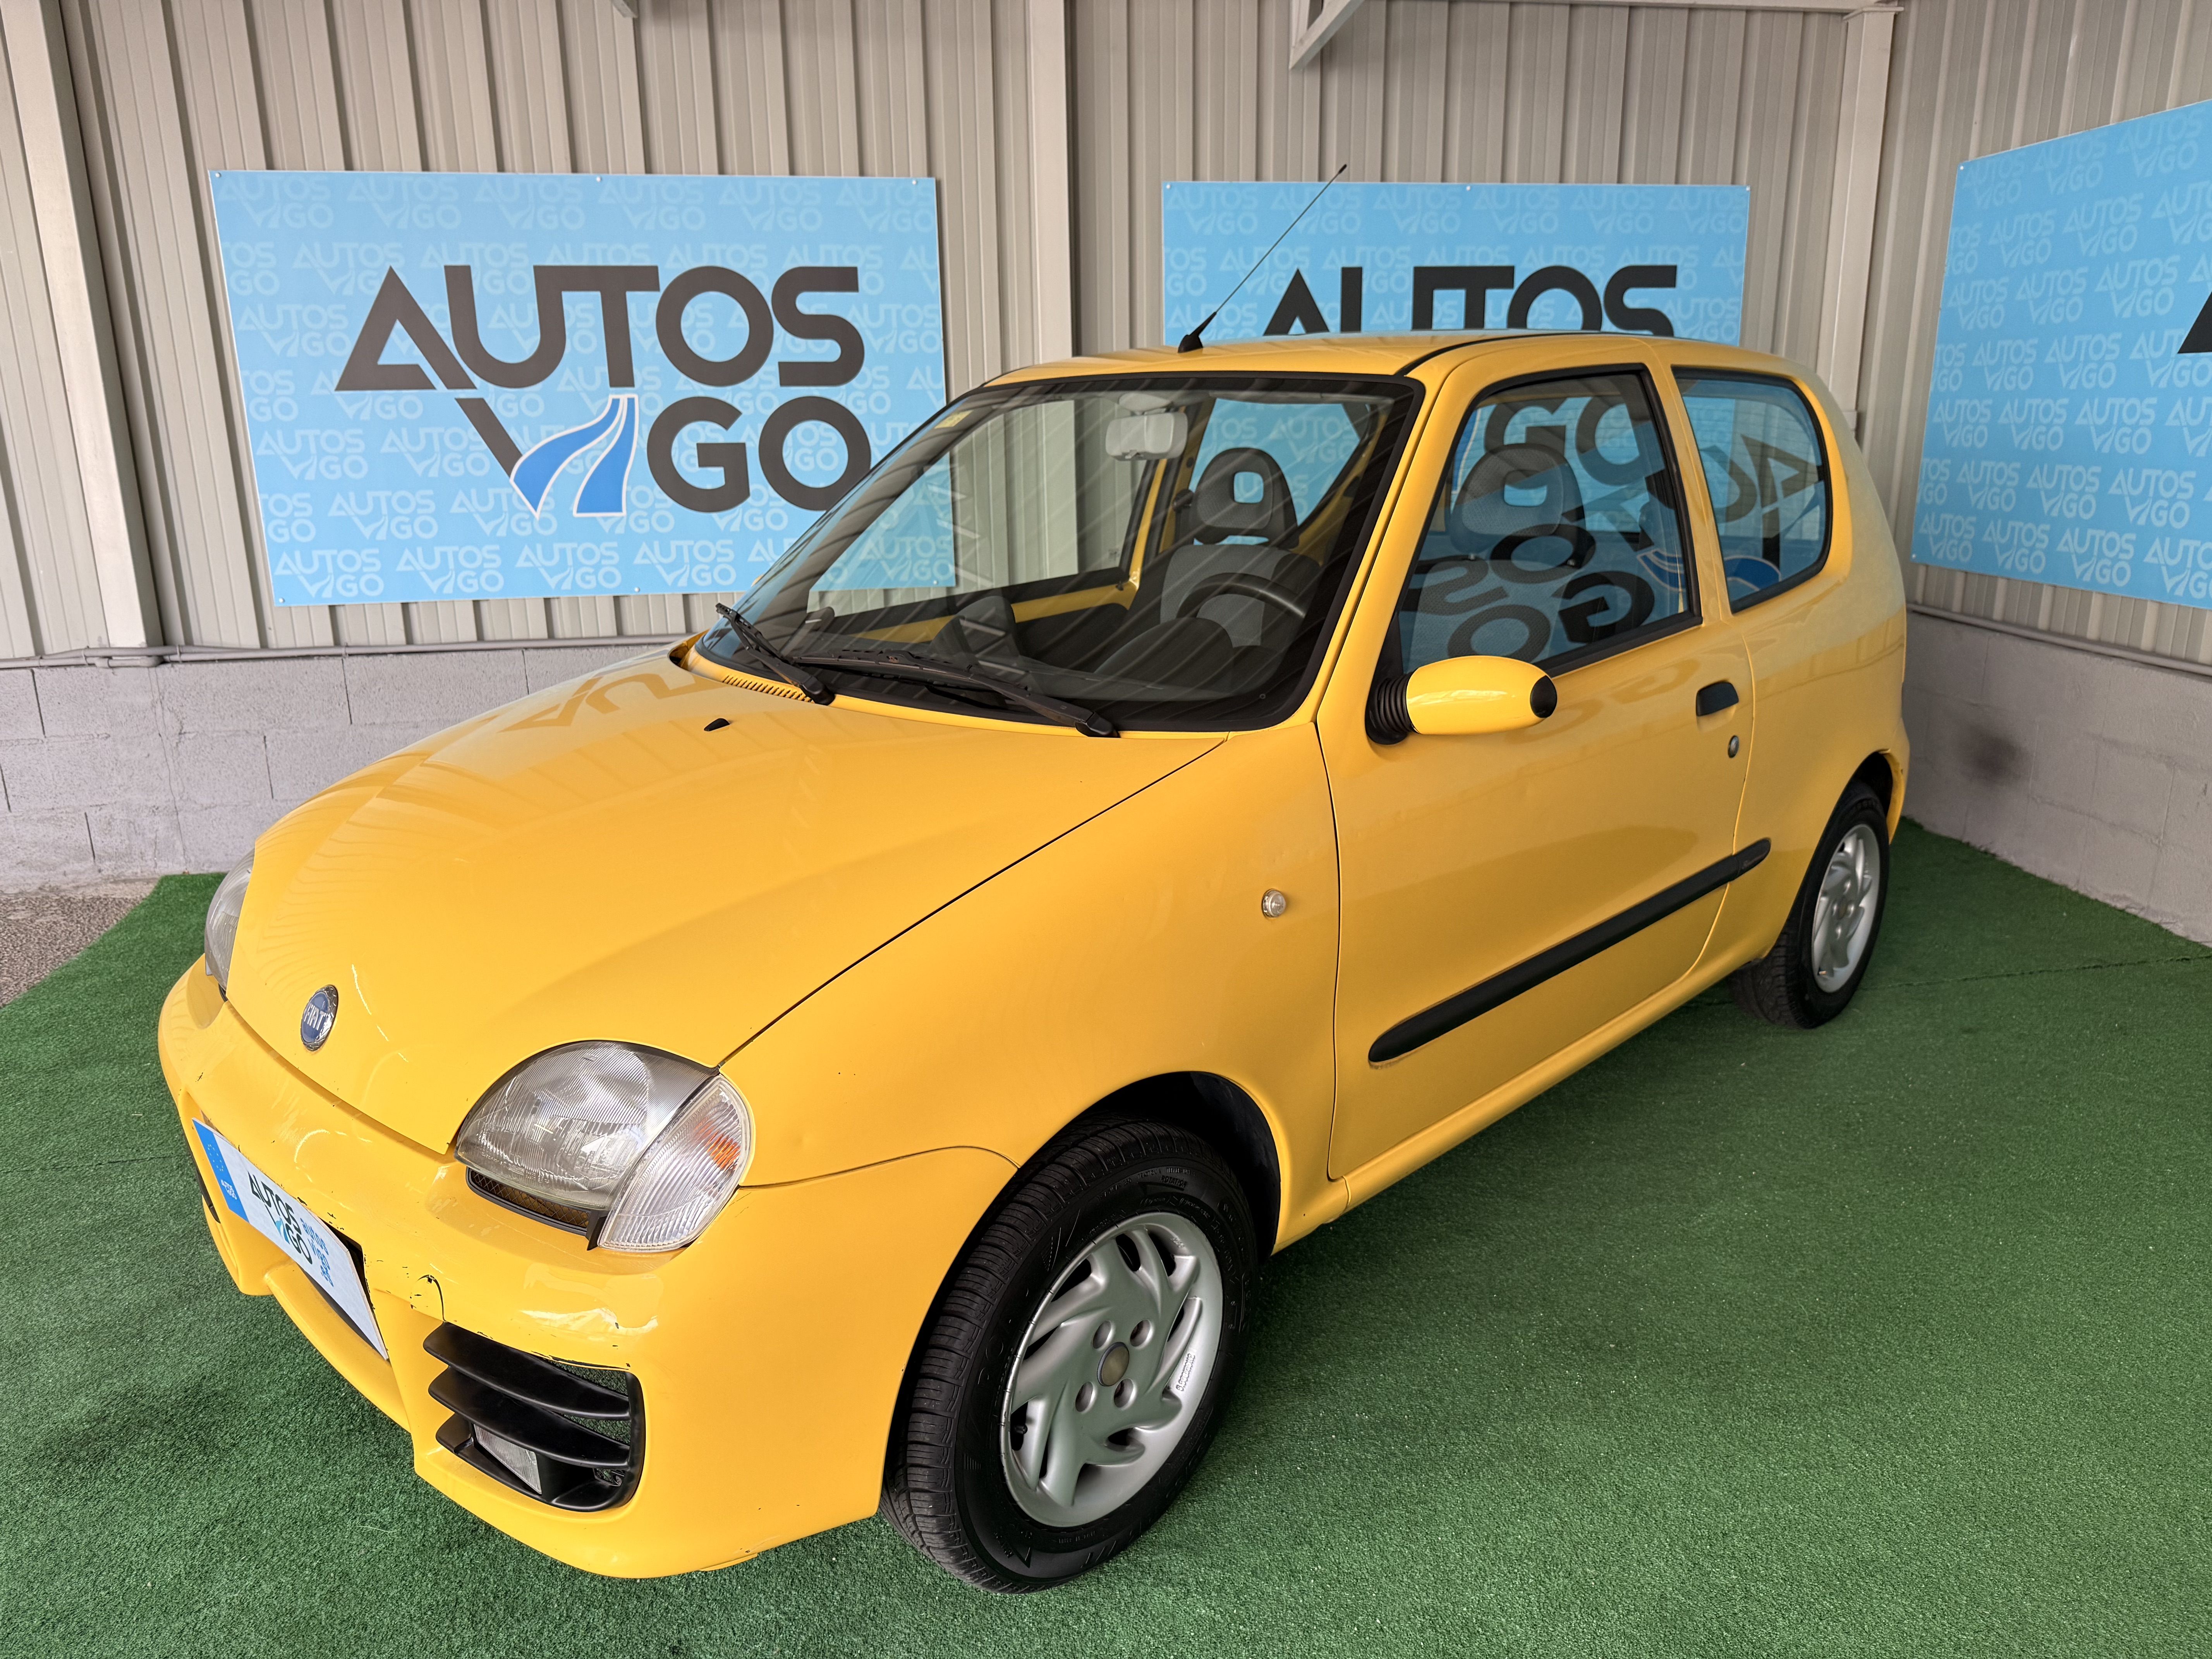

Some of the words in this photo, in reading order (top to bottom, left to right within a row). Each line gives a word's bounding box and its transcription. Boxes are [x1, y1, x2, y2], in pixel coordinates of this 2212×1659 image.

[220, 179, 330, 204] AUTOS
[349, 180, 458, 204] AUTOS
[476, 181, 582, 205] AUTOS
[599, 182, 704, 206] AUTOS
[720, 183, 823, 207] AUTOS
[2063, 193, 2144, 234] AUTOS
[2015, 266, 2089, 301] AUTOS
[2094, 256, 2181, 293] AUTOS
[1946, 277, 2010, 308] AUTOS
[2111, 286, 2174, 318] VIGO
[239, 304, 347, 330] AUTOS
[2029, 295, 2083, 324] VIGO
[335, 265, 864, 390] AUTOS
[264, 332, 351, 356] VIGO
[1971, 338, 2039, 367] AUTOS
[2044, 332, 2122, 364] AUTOS
[1984, 365, 2033, 391] VIGO
[2060, 361, 2117, 390] VIGO
[337, 395, 422, 420] VIGO
[1932, 399, 1993, 424] AUTOS
[1997, 398, 2069, 425] AUTOS
[2075, 398, 2157, 426] AUTOS
[258, 429, 364, 455] AUTOS
[1944, 424, 1988, 449] VIGO
[2011, 424, 2063, 452] VIGO
[2091, 426, 2152, 455] VIGO
[282, 455, 368, 480] VIGO
[406, 453, 489, 477] VIGO
[454, 395, 871, 519] VIGO
[1956, 460, 2021, 489] AUTOS
[2026, 464, 2102, 496] AUTOS
[2108, 468, 2196, 503] AUTOS
[329, 490, 434, 516] AUTOS
[1968, 485, 2016, 513] VIGO
[2040, 490, 2096, 521] VIGO
[475, 513, 556, 537] VIGO
[2124, 496, 2190, 530] VIGO
[353, 515, 437, 540] VIGO
[1919, 513, 1977, 542] AUTOS
[1982, 520, 2050, 551] AUTOS
[398, 545, 500, 571] AUTOS
[517, 543, 618, 568] AUTOS
[634, 540, 733, 565] AUTOS
[1930, 536, 1972, 563] VIGO
[2056, 527, 2136, 563] AUTOS
[276, 548, 380, 574] AUTOS
[1994, 544, 2046, 575] VIGO
[2070, 553, 2131, 588] VIGO
[300, 573, 384, 598] VIGO
[421, 570, 503, 594] VIGO
[540, 567, 620, 591] VIGO
[657, 563, 735, 587] VIGO
[304, 1003, 326, 1030] FIAT
[1160, 1175, 1187, 1188] ROTATION
[248, 1171, 301, 1235] AUTOS
[264, 1204, 313, 1264] VIGO
[300, 1218, 329, 1255] autos
[307, 1238, 330, 1272] vigo
